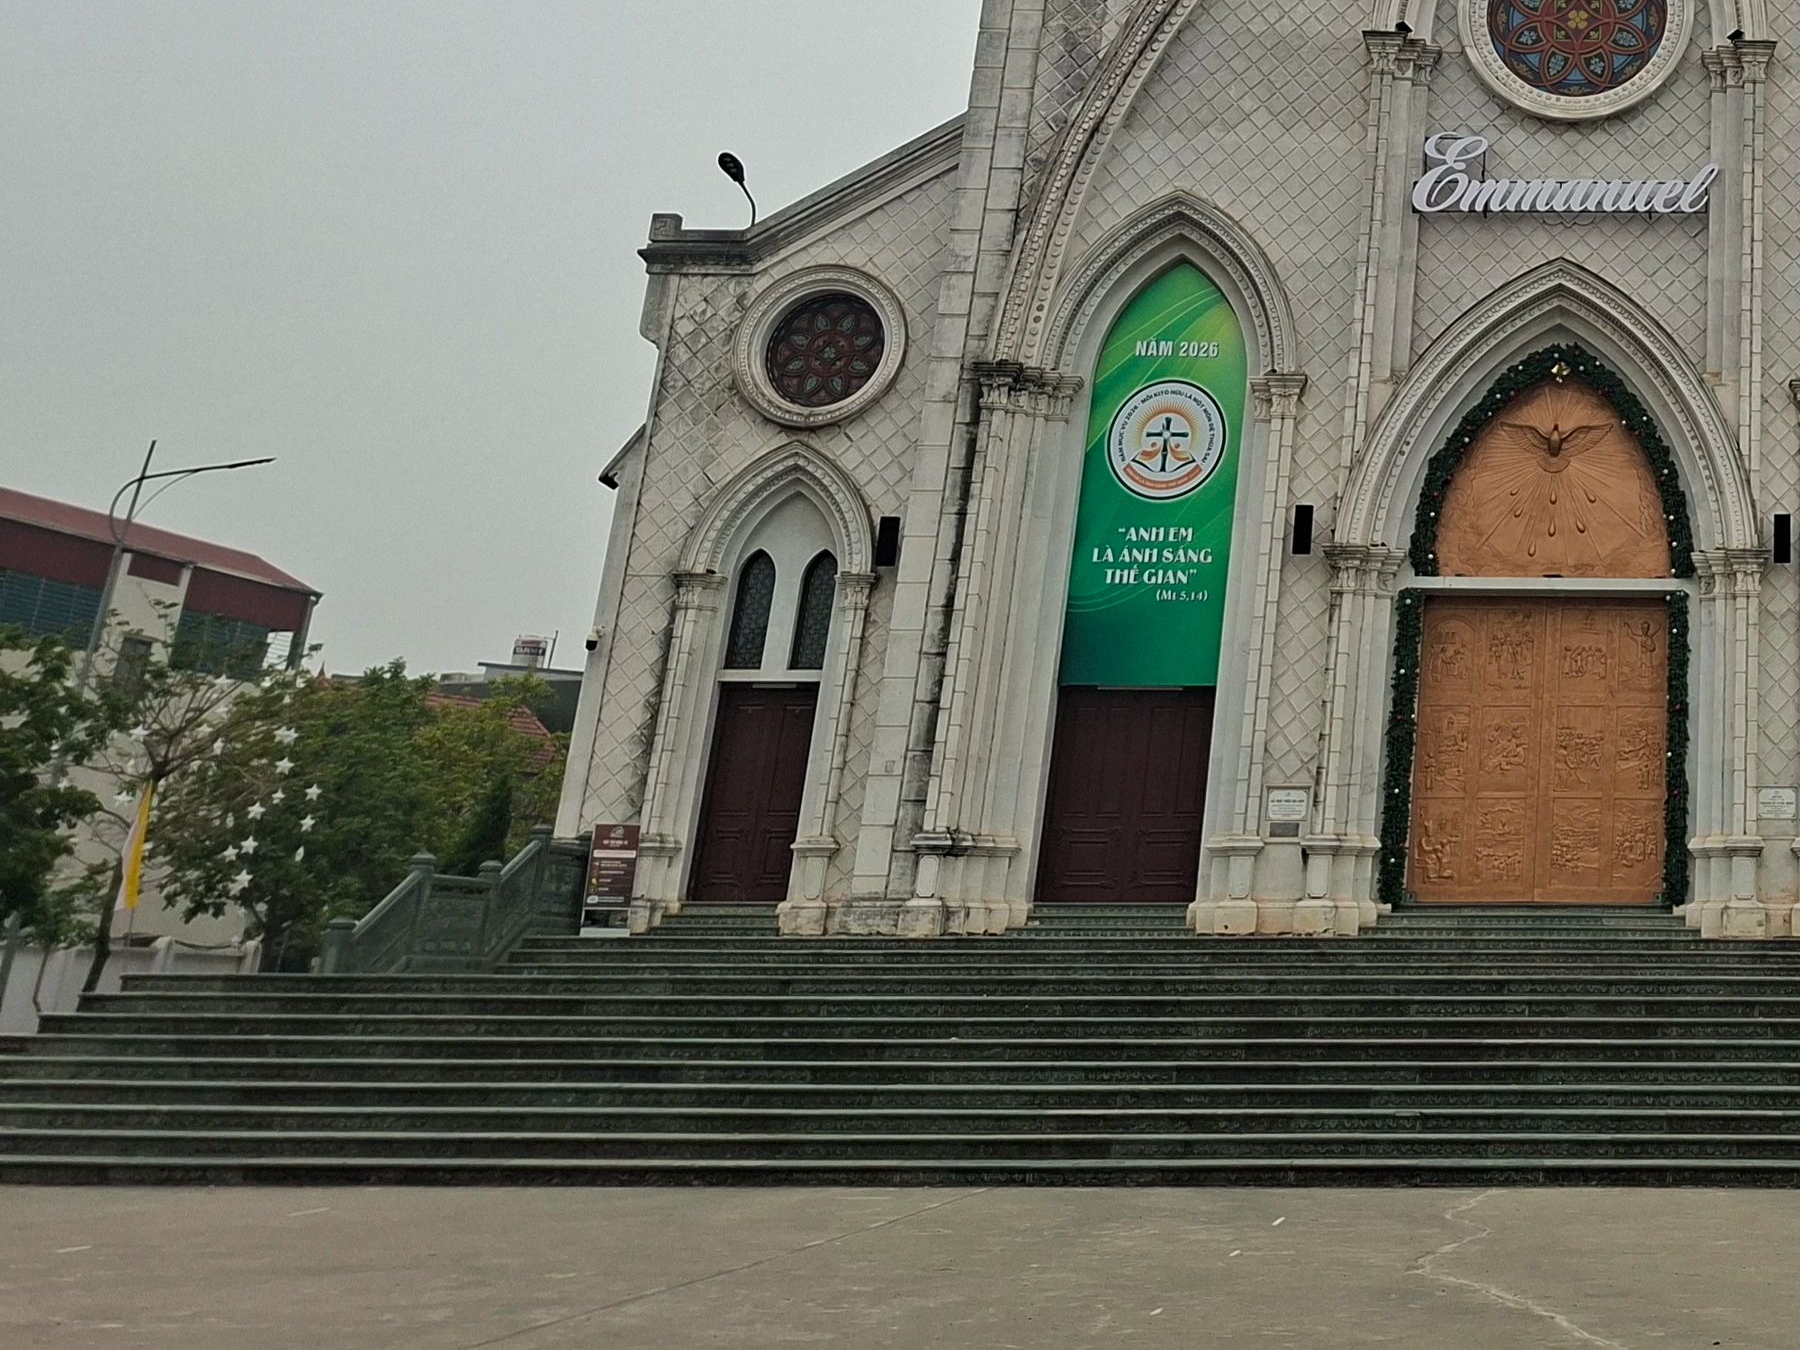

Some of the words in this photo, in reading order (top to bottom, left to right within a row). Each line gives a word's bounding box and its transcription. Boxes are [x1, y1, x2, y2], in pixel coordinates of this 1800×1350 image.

[1412, 131, 1719, 213] Emmanuel
[1135, 337, 1173, 357] NĂM
[1178, 341, 1219, 358] 2026
[1168, 527, 1193, 542] EM
[1092, 544, 1114, 563] LÀ
[1118, 544, 1158, 563] ÁNH
[1161, 544, 1213, 563] SÁNG
[1104, 563, 1140, 585] THẾ
